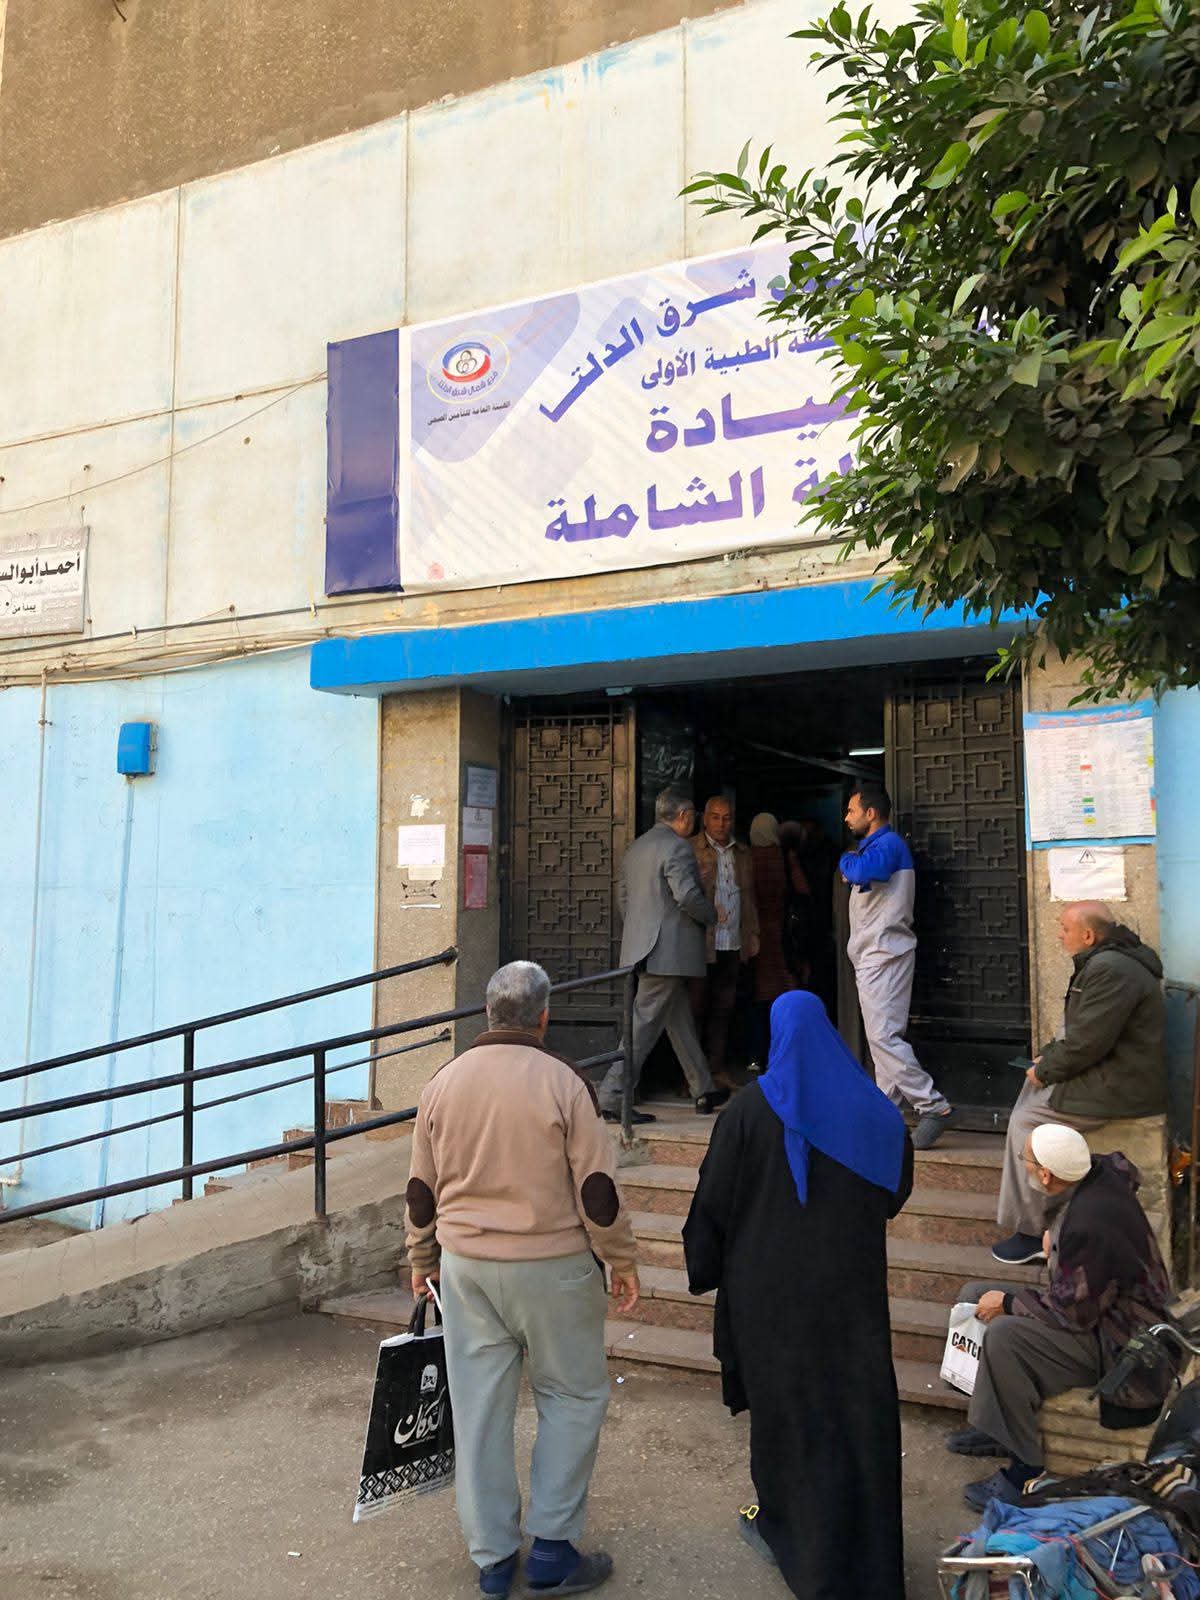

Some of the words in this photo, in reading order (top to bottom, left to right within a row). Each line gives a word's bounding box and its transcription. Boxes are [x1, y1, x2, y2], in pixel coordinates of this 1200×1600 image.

[656, 268, 756, 337] شرق
[539, 317, 644, 422] الدلتا
[641, 347, 696, 390] الأولى
[704, 332, 779, 375] الطبية
[544, 466, 765, 543] الشاملة
[40, 552, 80, 576] أحمد
